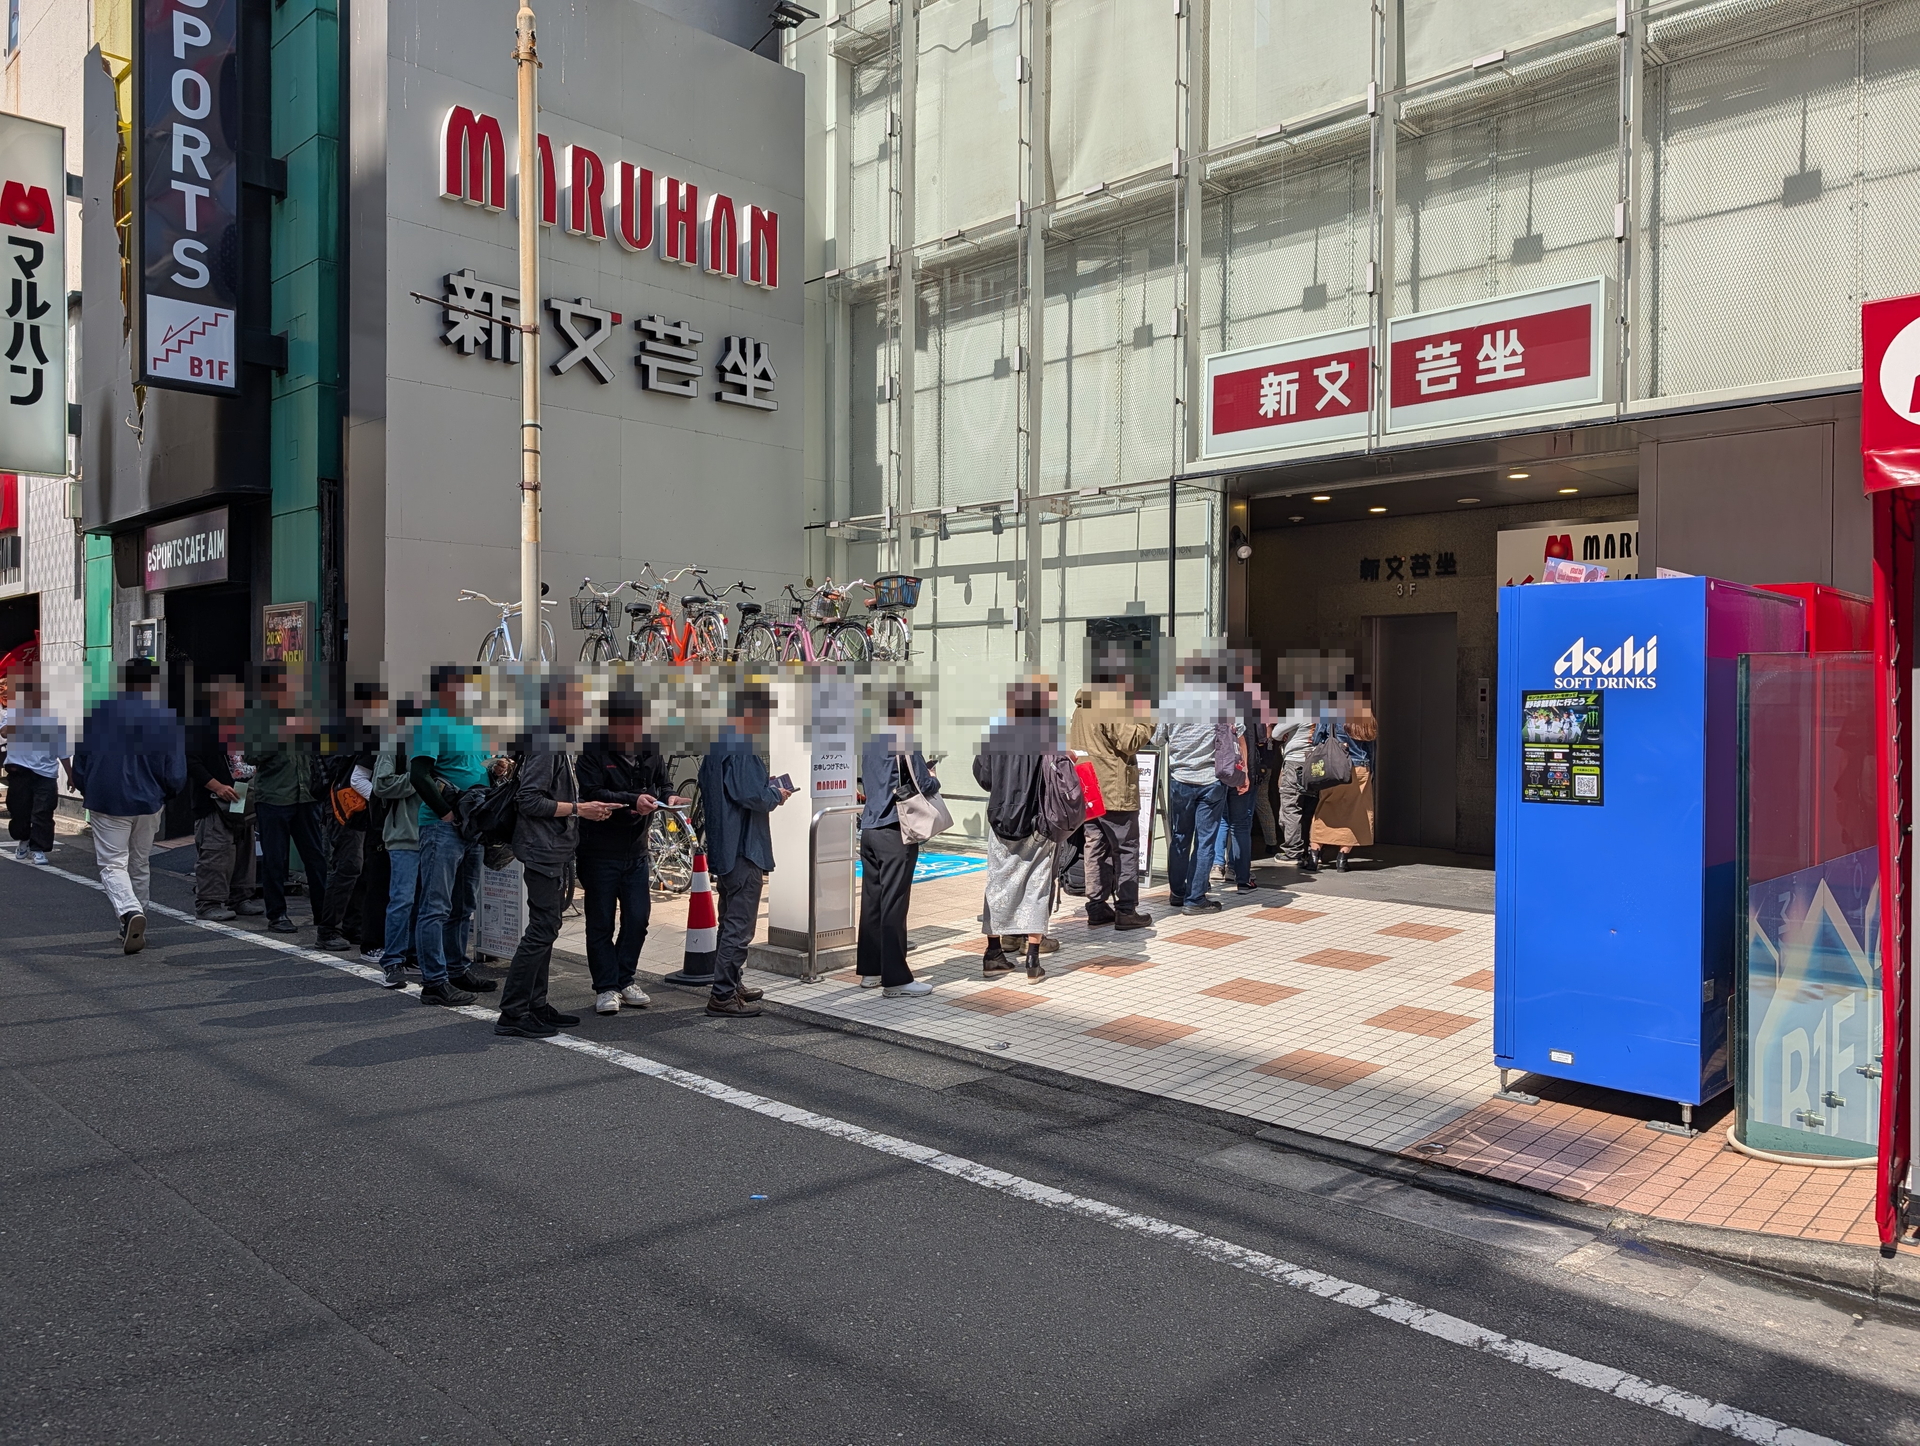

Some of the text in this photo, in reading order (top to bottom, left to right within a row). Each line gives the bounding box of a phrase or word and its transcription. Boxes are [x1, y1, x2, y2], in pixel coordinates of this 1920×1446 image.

[171, 0, 212, 289] PORTS
[5, 236, 51, 406] マルハン
[440, 268, 779, 412] 新文芸坐
[189, 356, 229, 381] B1F
[1258, 329, 1527, 419] 新文芸坐
[147, 528, 225, 573] eSPORTS CAFE AIM
[1360, 552, 1457, 581] 新文芸坐
[1582, 531, 1639, 560] MAR
[1554, 634, 1658, 677] Asahi
[1554, 676, 1657, 690] SOFT DRINKS
[816, 779, 847, 791] MARUHAN
